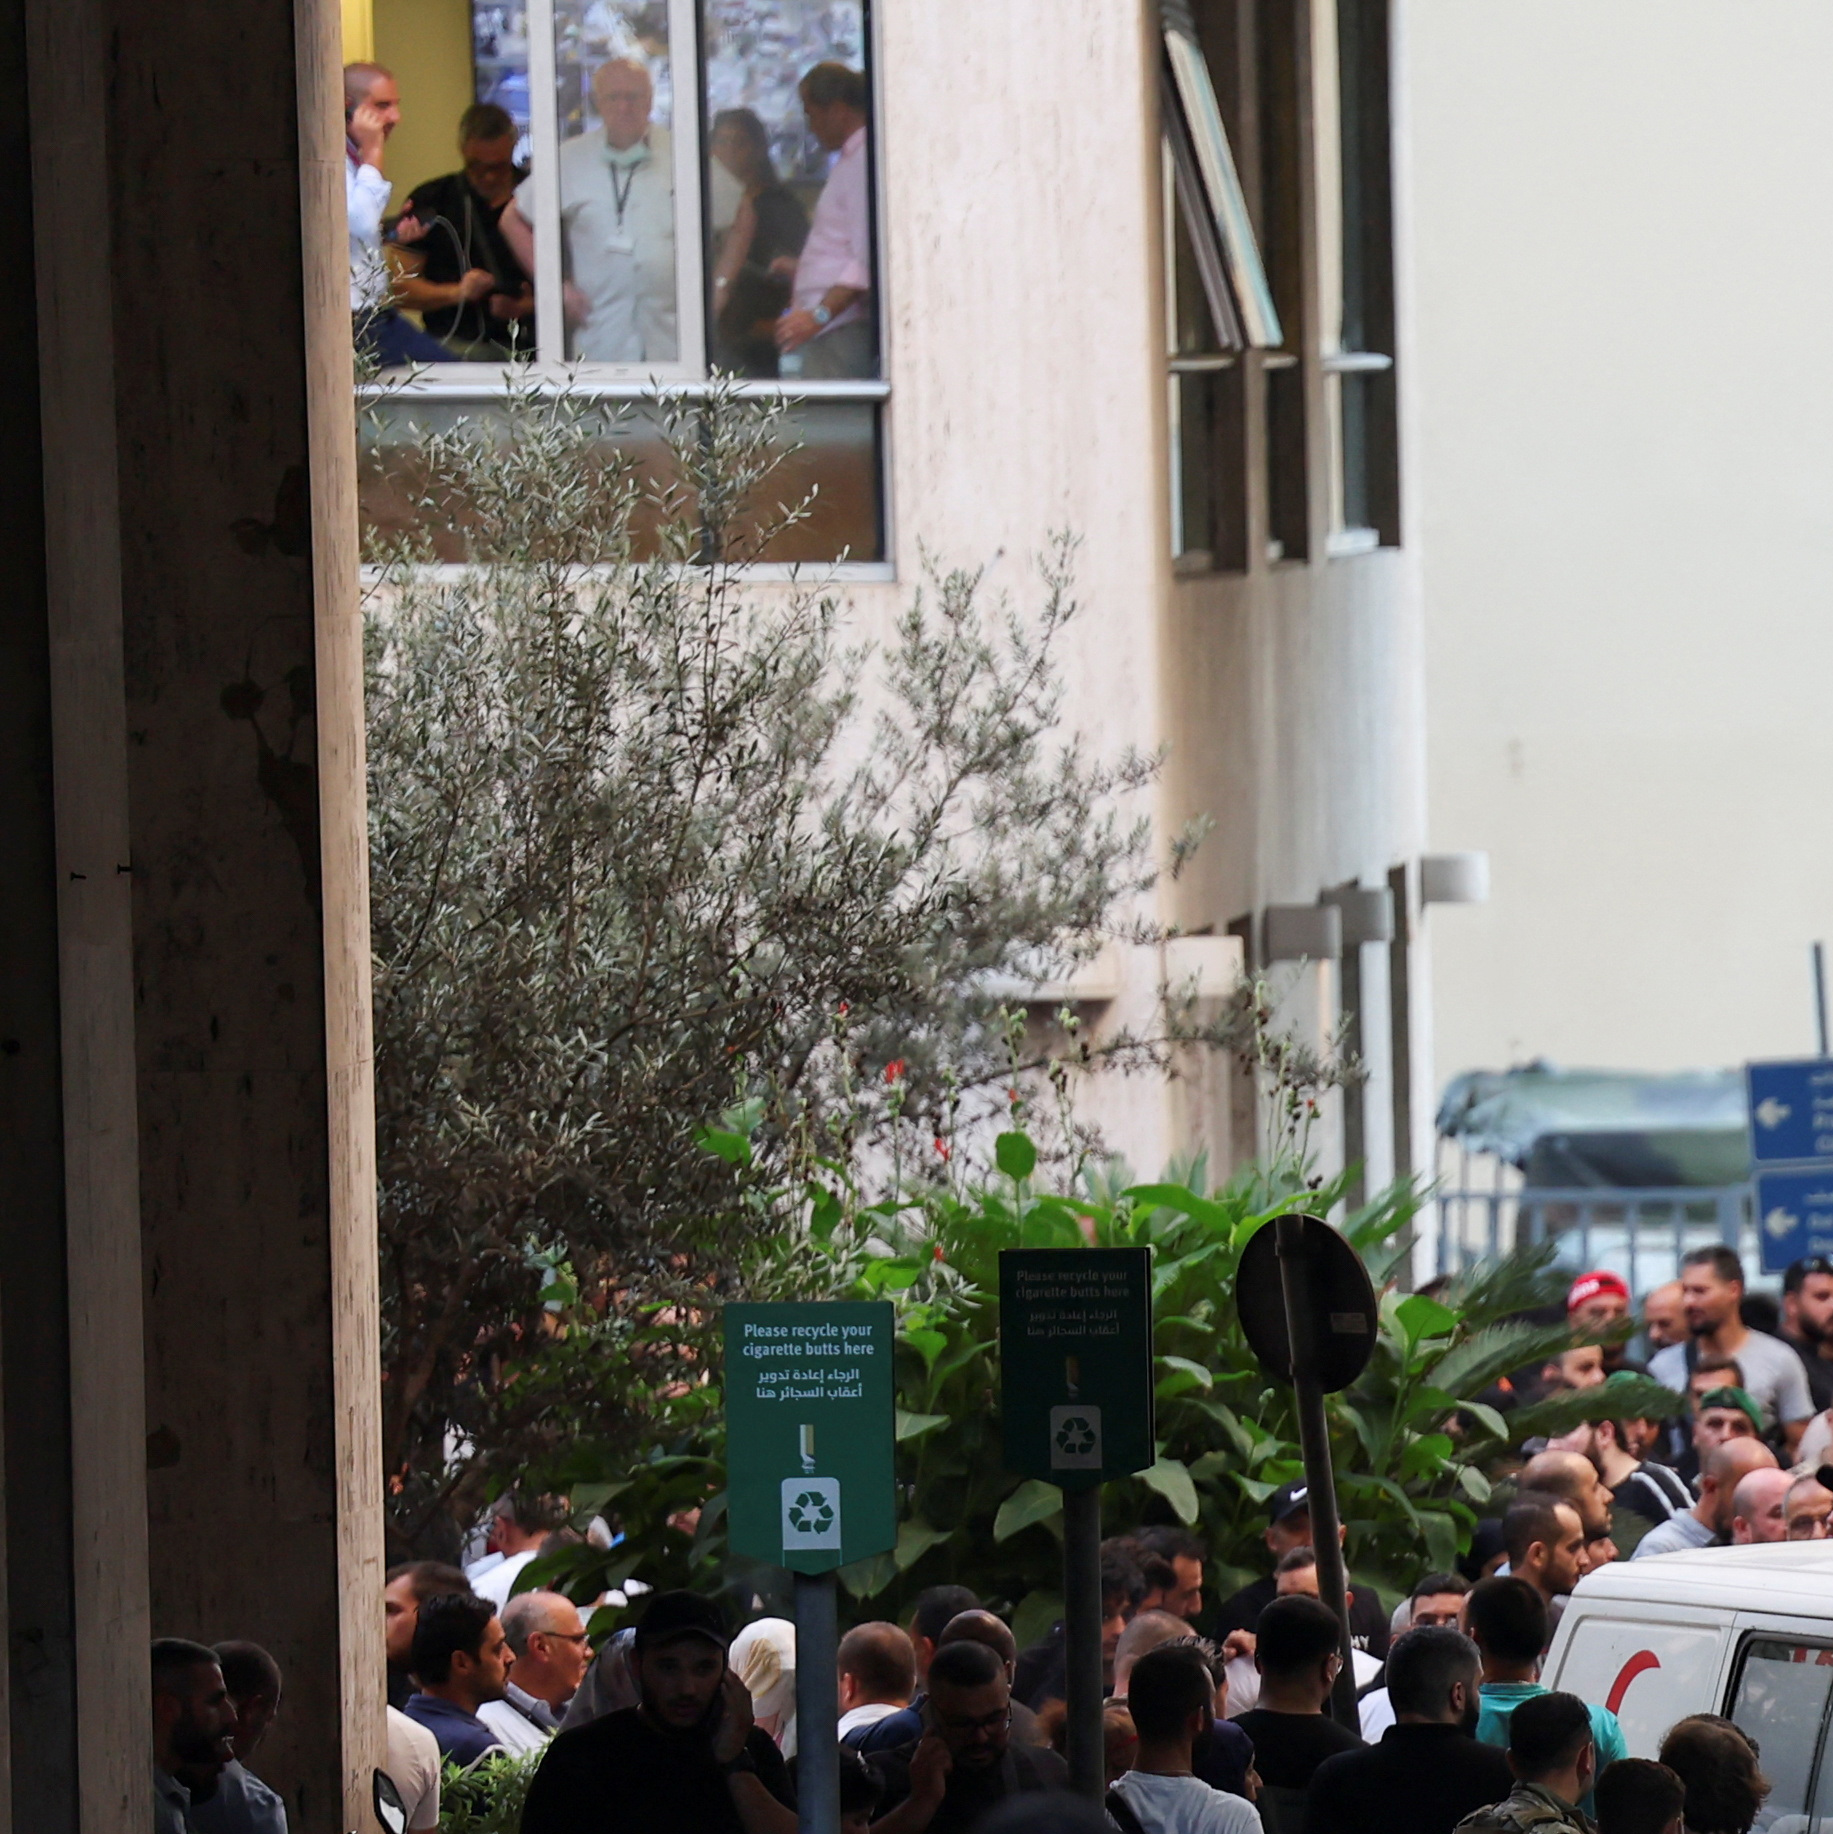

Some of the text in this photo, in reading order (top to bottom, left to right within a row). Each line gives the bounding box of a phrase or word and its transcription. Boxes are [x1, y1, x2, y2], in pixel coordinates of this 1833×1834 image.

[1016, 1269, 1128, 1283] Please recycle your
[1016, 1285, 1129, 1300] cigarette butts here
[744, 1322, 873, 1340] Please recycle your
[743, 1341, 875, 1359] cigarette butts here
[758, 1369, 860, 1384] الرجاء إعادة تدوير
[756, 1383, 862, 1401] أعقاب السجائر هنا
